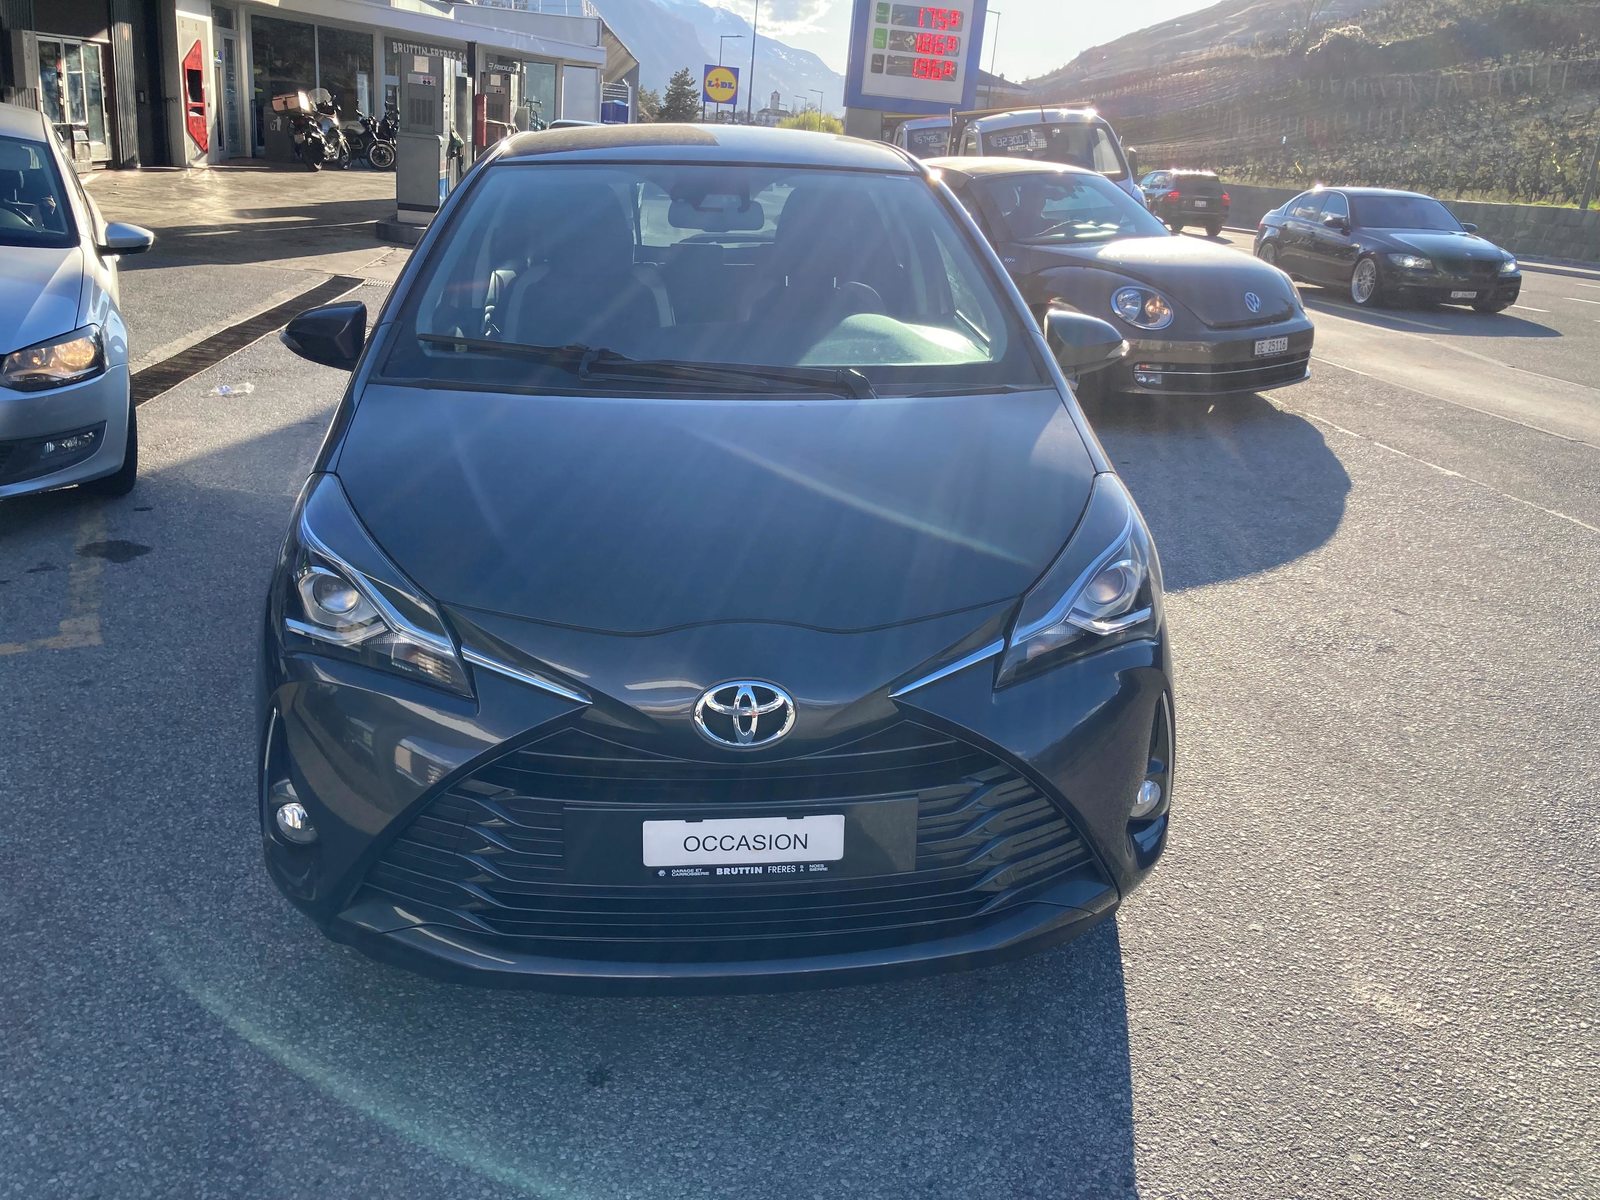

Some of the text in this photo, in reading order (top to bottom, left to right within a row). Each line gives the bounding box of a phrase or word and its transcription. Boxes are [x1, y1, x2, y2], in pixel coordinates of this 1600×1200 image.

[392, 41, 428, 55] BRUTTIN
[1257, 342, 1265, 353] GE
[683, 833, 809, 852] OCCASION
[716, 866, 763, 875] BRUTTIN
